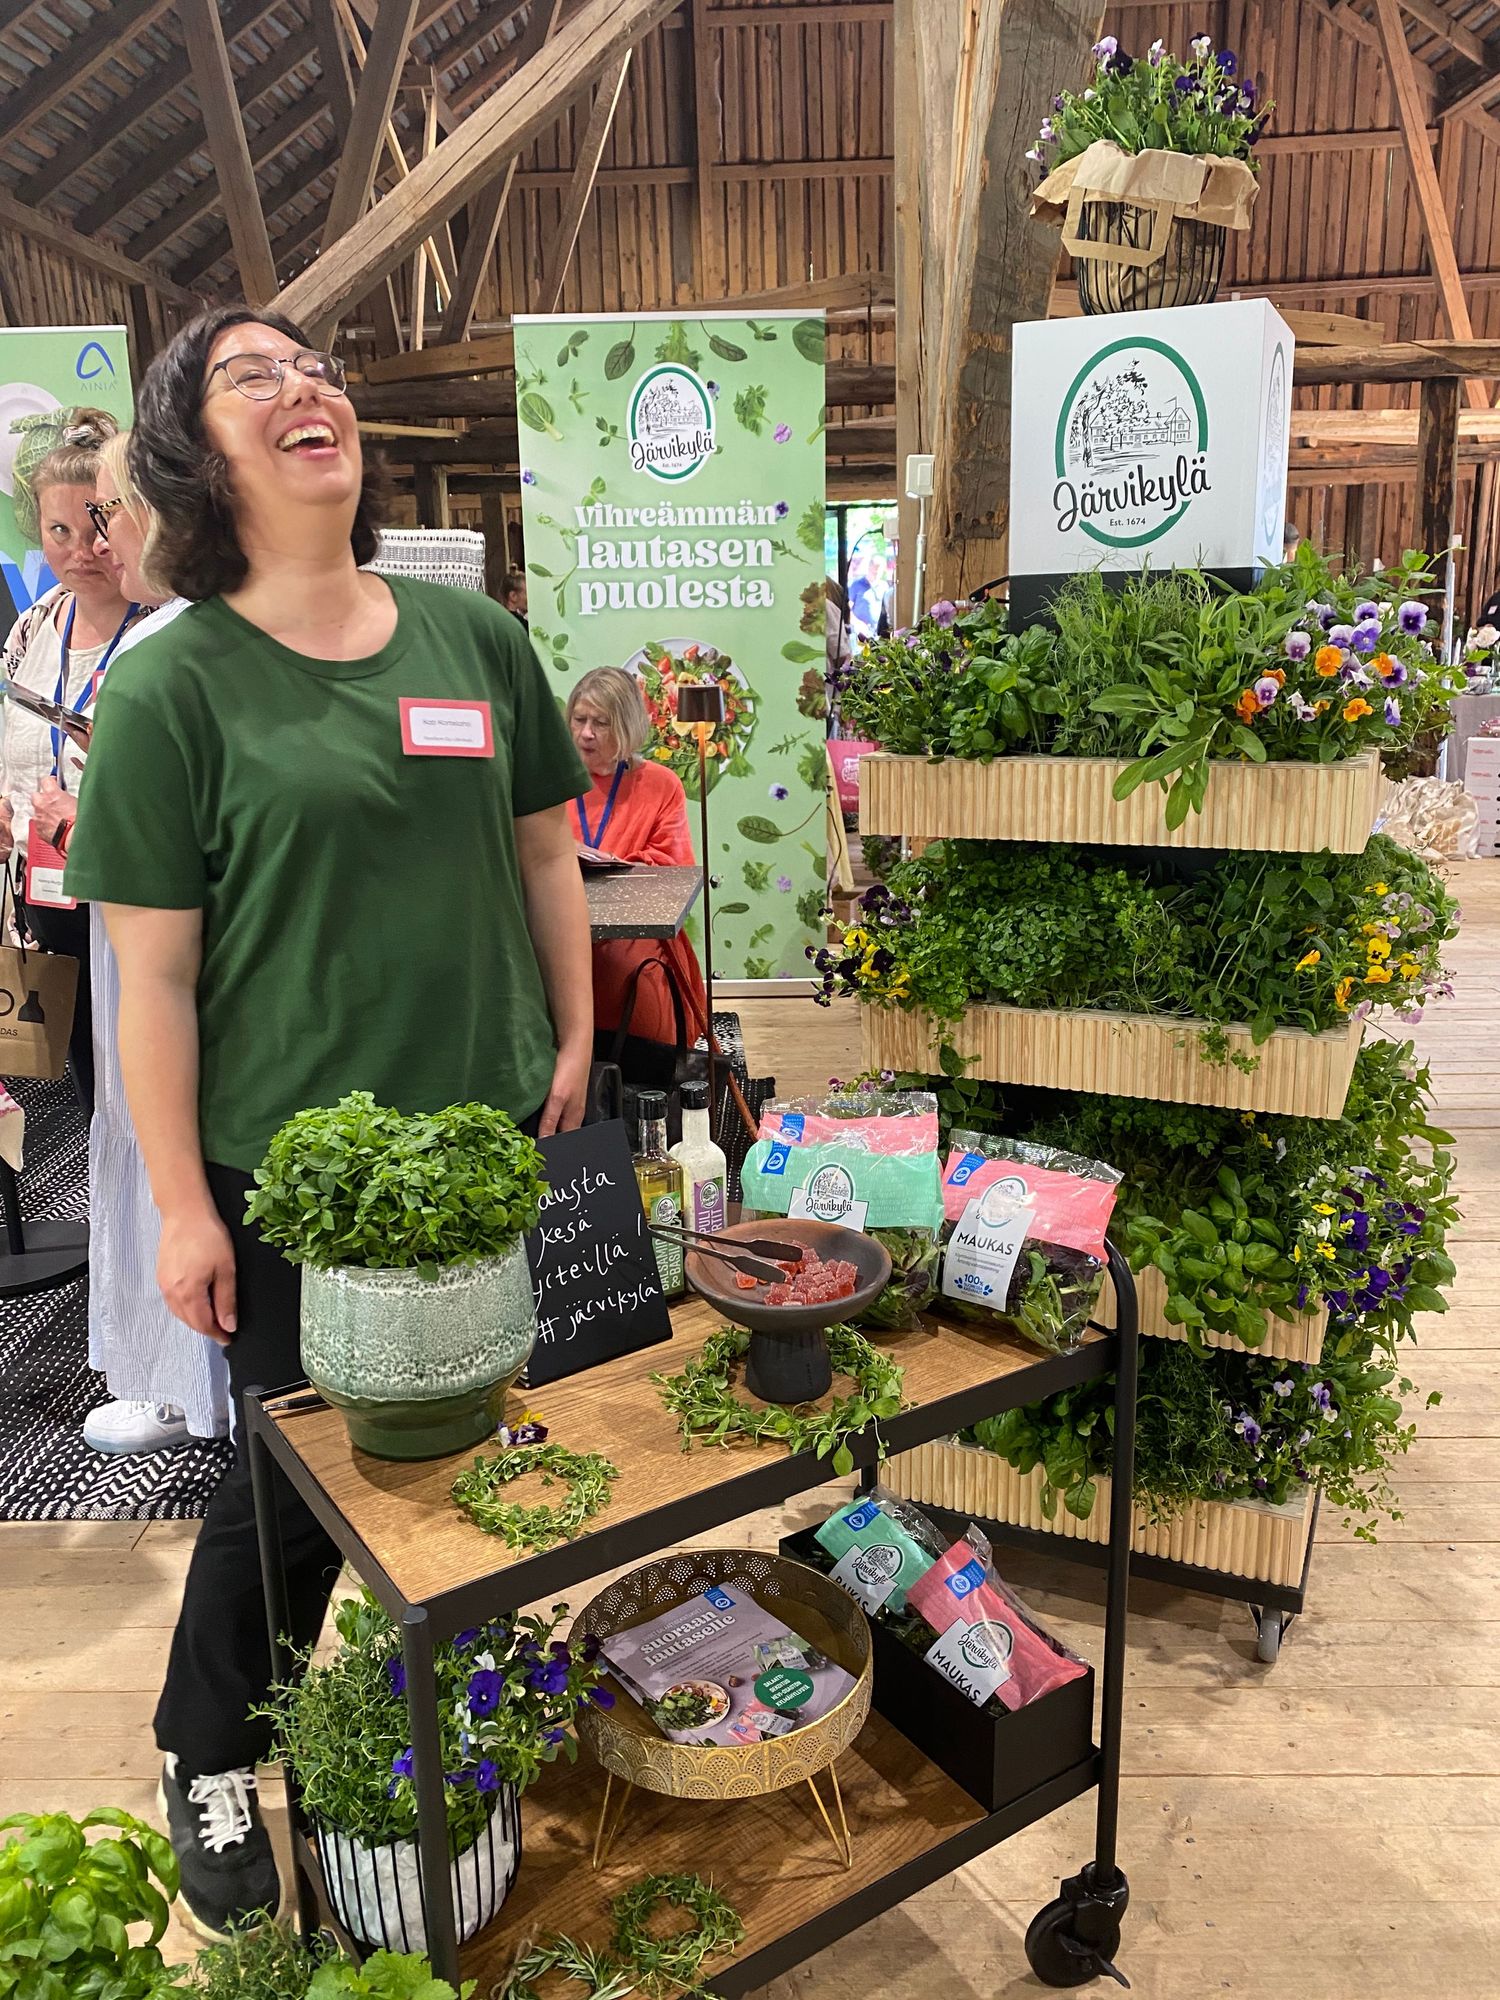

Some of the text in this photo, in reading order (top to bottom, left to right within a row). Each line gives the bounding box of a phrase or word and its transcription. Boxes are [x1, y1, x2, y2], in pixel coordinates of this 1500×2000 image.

[631, 430, 714, 470] Järvikylä
[1053, 454, 1211, 532] Järvikylä
[1109, 517, 1146, 527] Est. 1674
[573, 533, 775, 569] lautasen
[578, 574, 775, 616] puolesta
[805, 1197, 853, 1215] Järvikylä
[956, 1232, 1015, 1256] MAUKAS
[852, 1556, 888, 1585] Järvikylä
[640, 1610, 718, 1655] suoraan
[642, 1614, 736, 1668] lautaselle
[957, 1632, 999, 1671] Järvikylä
[932, 1649, 981, 1702] MAUKAS
